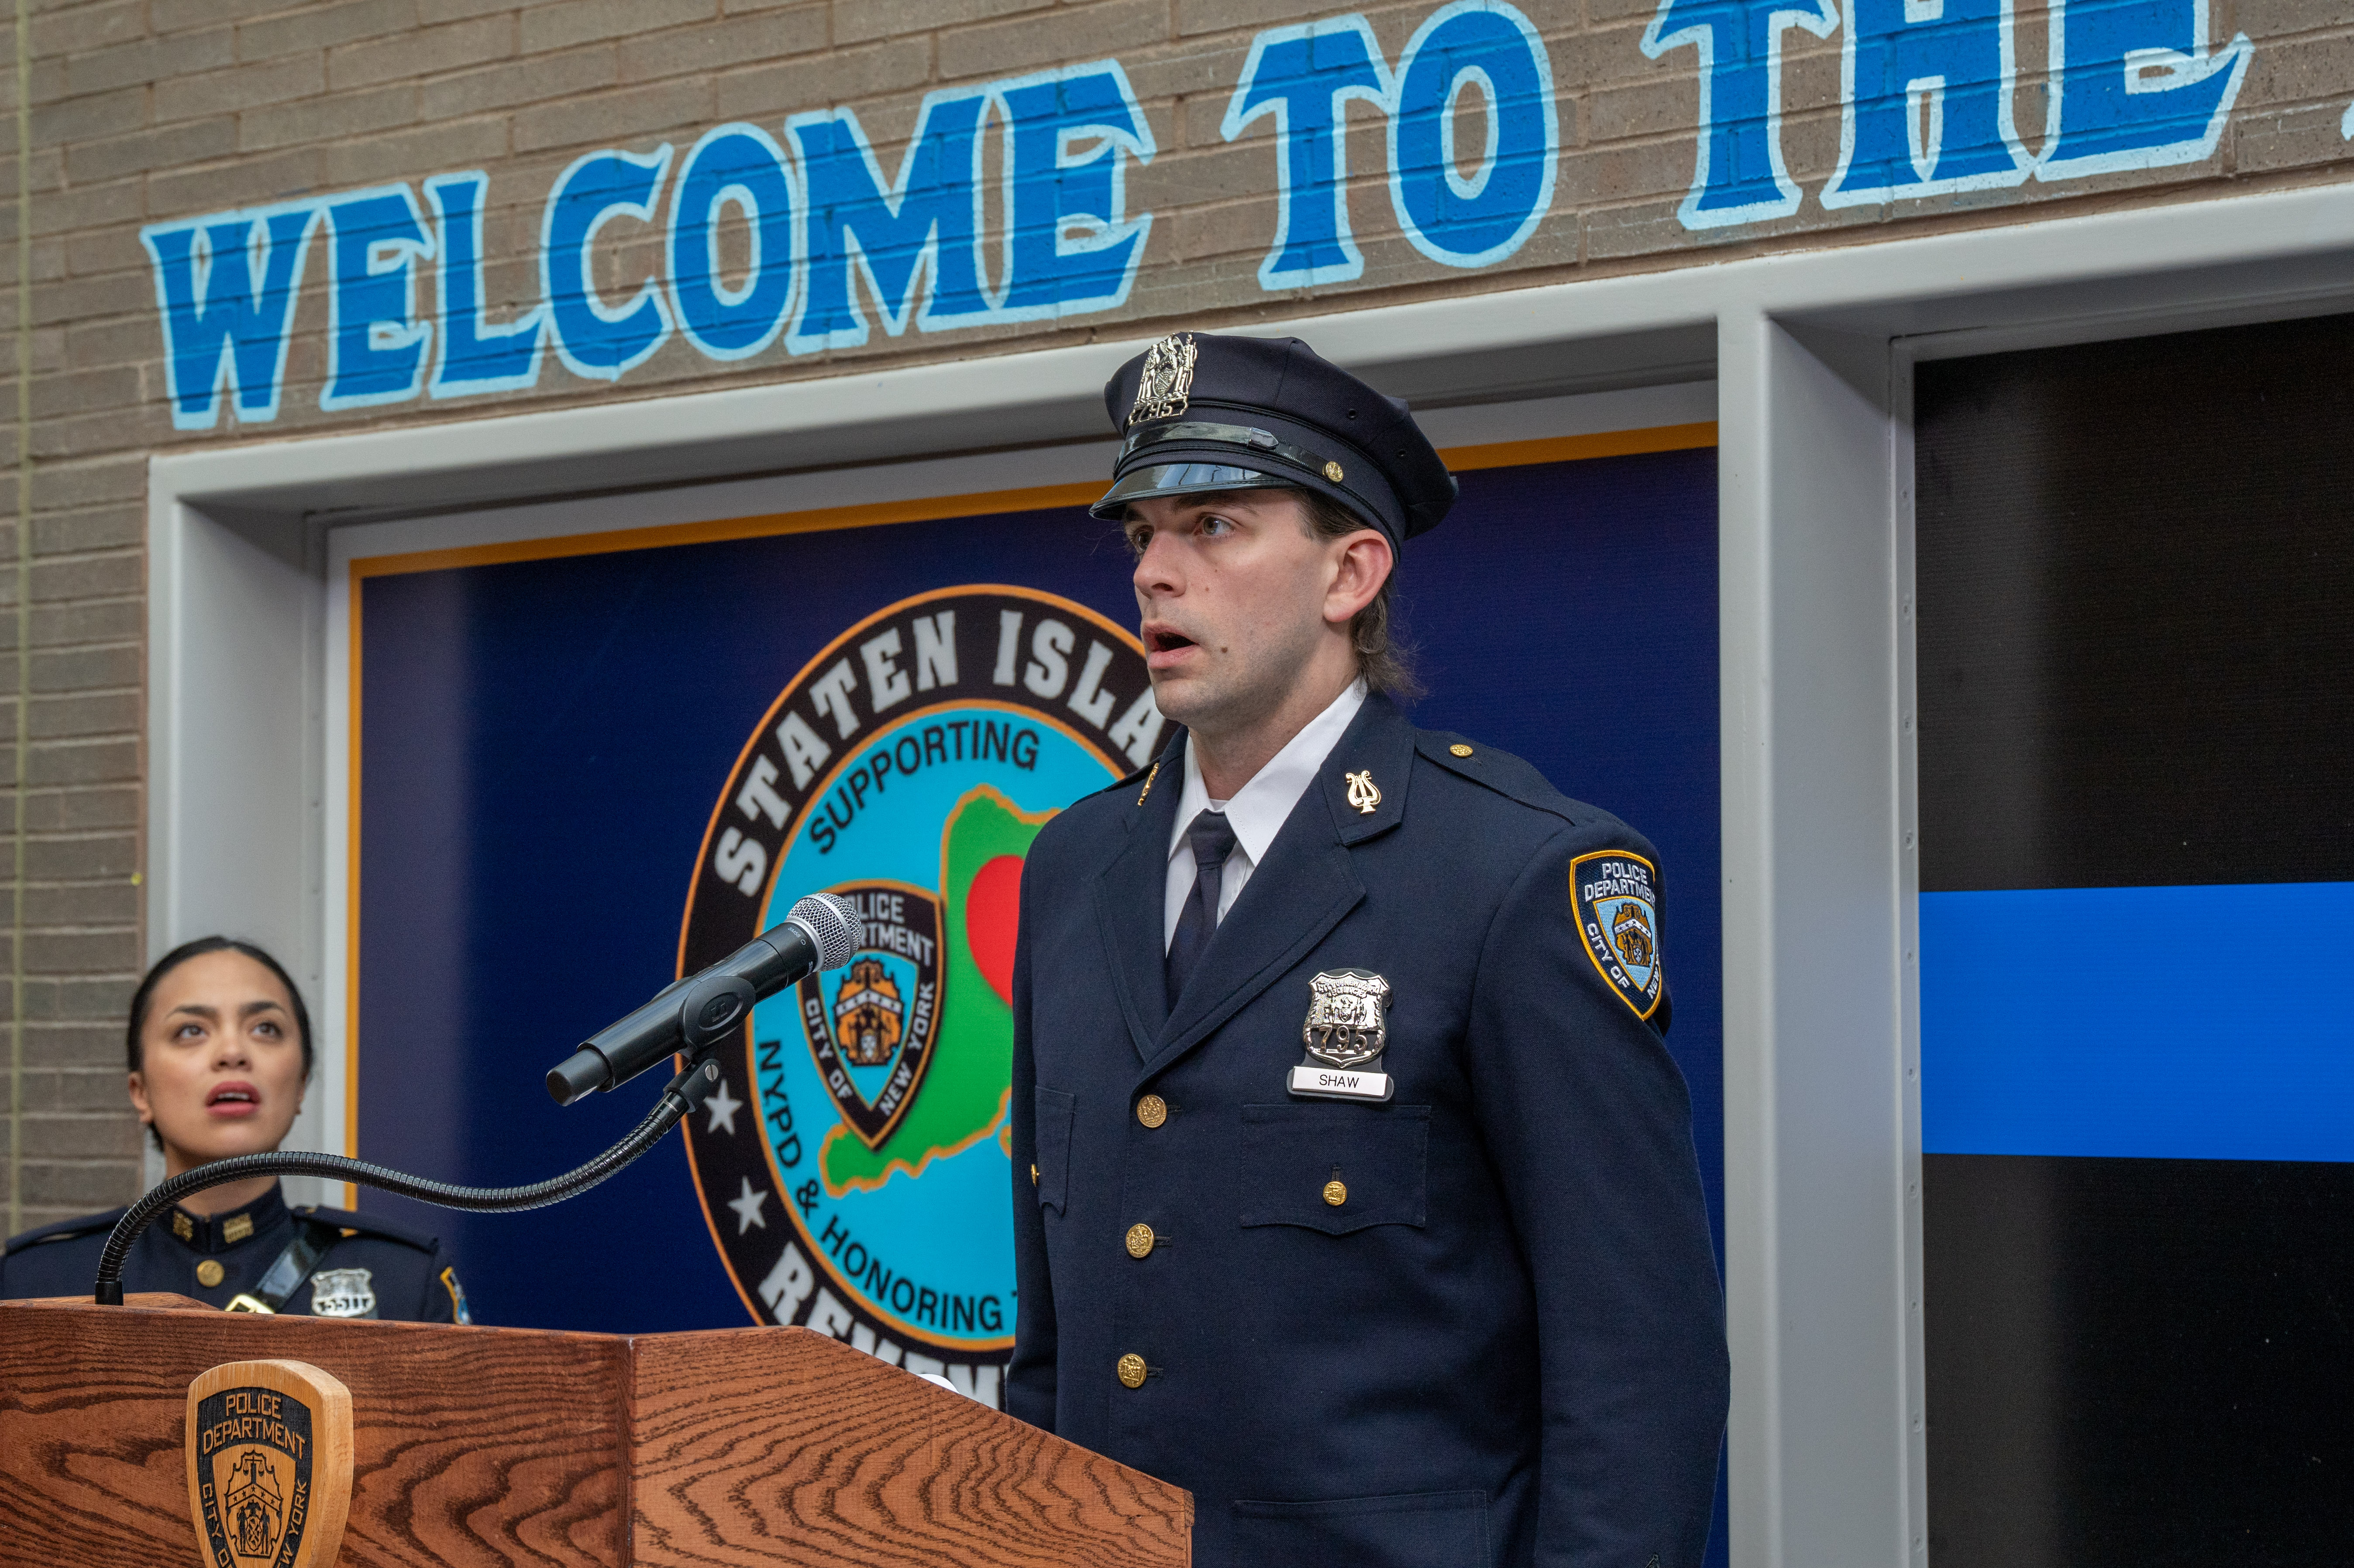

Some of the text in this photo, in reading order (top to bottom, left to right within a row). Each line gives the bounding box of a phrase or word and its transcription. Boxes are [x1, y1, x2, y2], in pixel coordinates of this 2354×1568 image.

[139, 0, 2255, 432] WELCOME TO THE
[1134, 399, 1173, 423] 795
[715, 609, 1166, 898] STATEN ISLA
[809, 720, 1040, 855] SUPPORTING
[1602, 863, 1648, 885] POLICE
[788, 927, 801, 938] SM58
[1587, 923, 1613, 961] CITY
[1610, 966, 1630, 988] OF
[1332, 986, 1366, 998] POLICE
[805, 981, 934, 1116] CITY OF NEW YORK
[1319, 1025, 1368, 1054] 795
[1319, 1074, 1359, 1088] SHAW
[757, 1040, 1003, 1332] NYPD & HONORING
[226, 1393, 282, 1420] POLICE
[203, 1417, 305, 1460] DEPARTMENT
[202, 1483, 222, 1538] CITY
[218, 1548, 234, 1568] O
[289, 1479, 307, 1535] YORK
